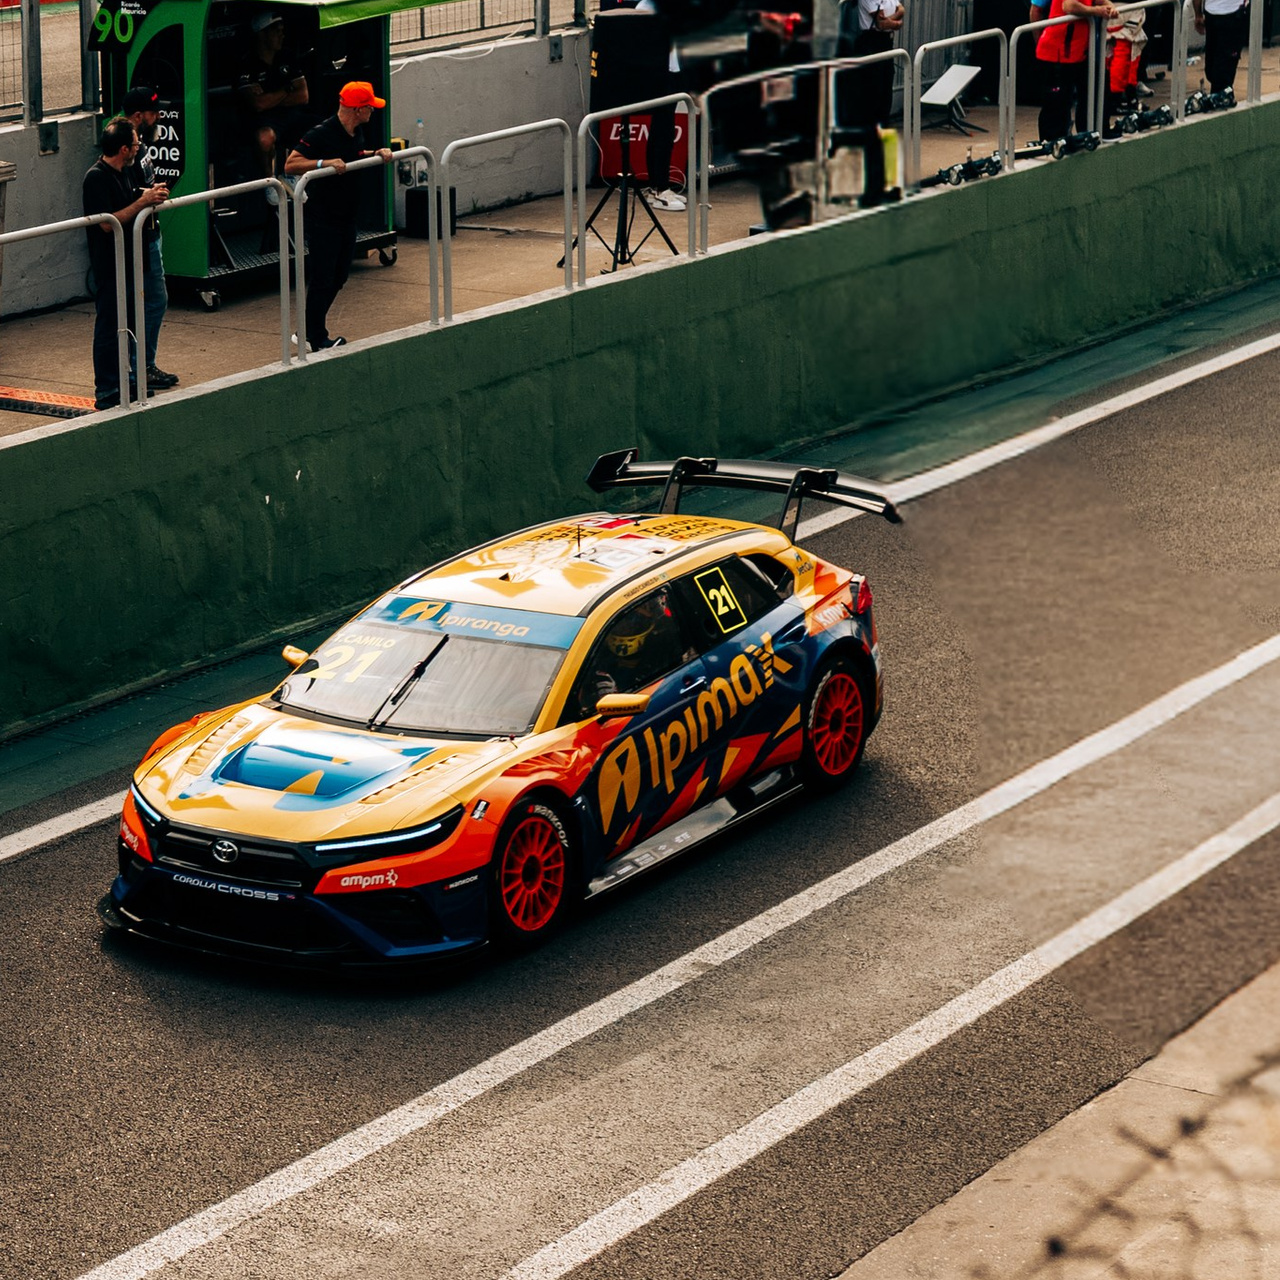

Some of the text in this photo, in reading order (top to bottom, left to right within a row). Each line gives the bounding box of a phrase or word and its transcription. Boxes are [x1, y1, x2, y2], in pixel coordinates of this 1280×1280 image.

[94, 7, 134, 43] 90
[609, 122, 683, 144] DENO
[707, 583, 738, 617] 21
[437, 610, 531, 638] Ipiranga
[303, 644, 384, 683] 21
[172, 873, 216, 890] COROLLA
[217, 883, 280, 901] CROSS
[340, 874, 384, 889] ampm
